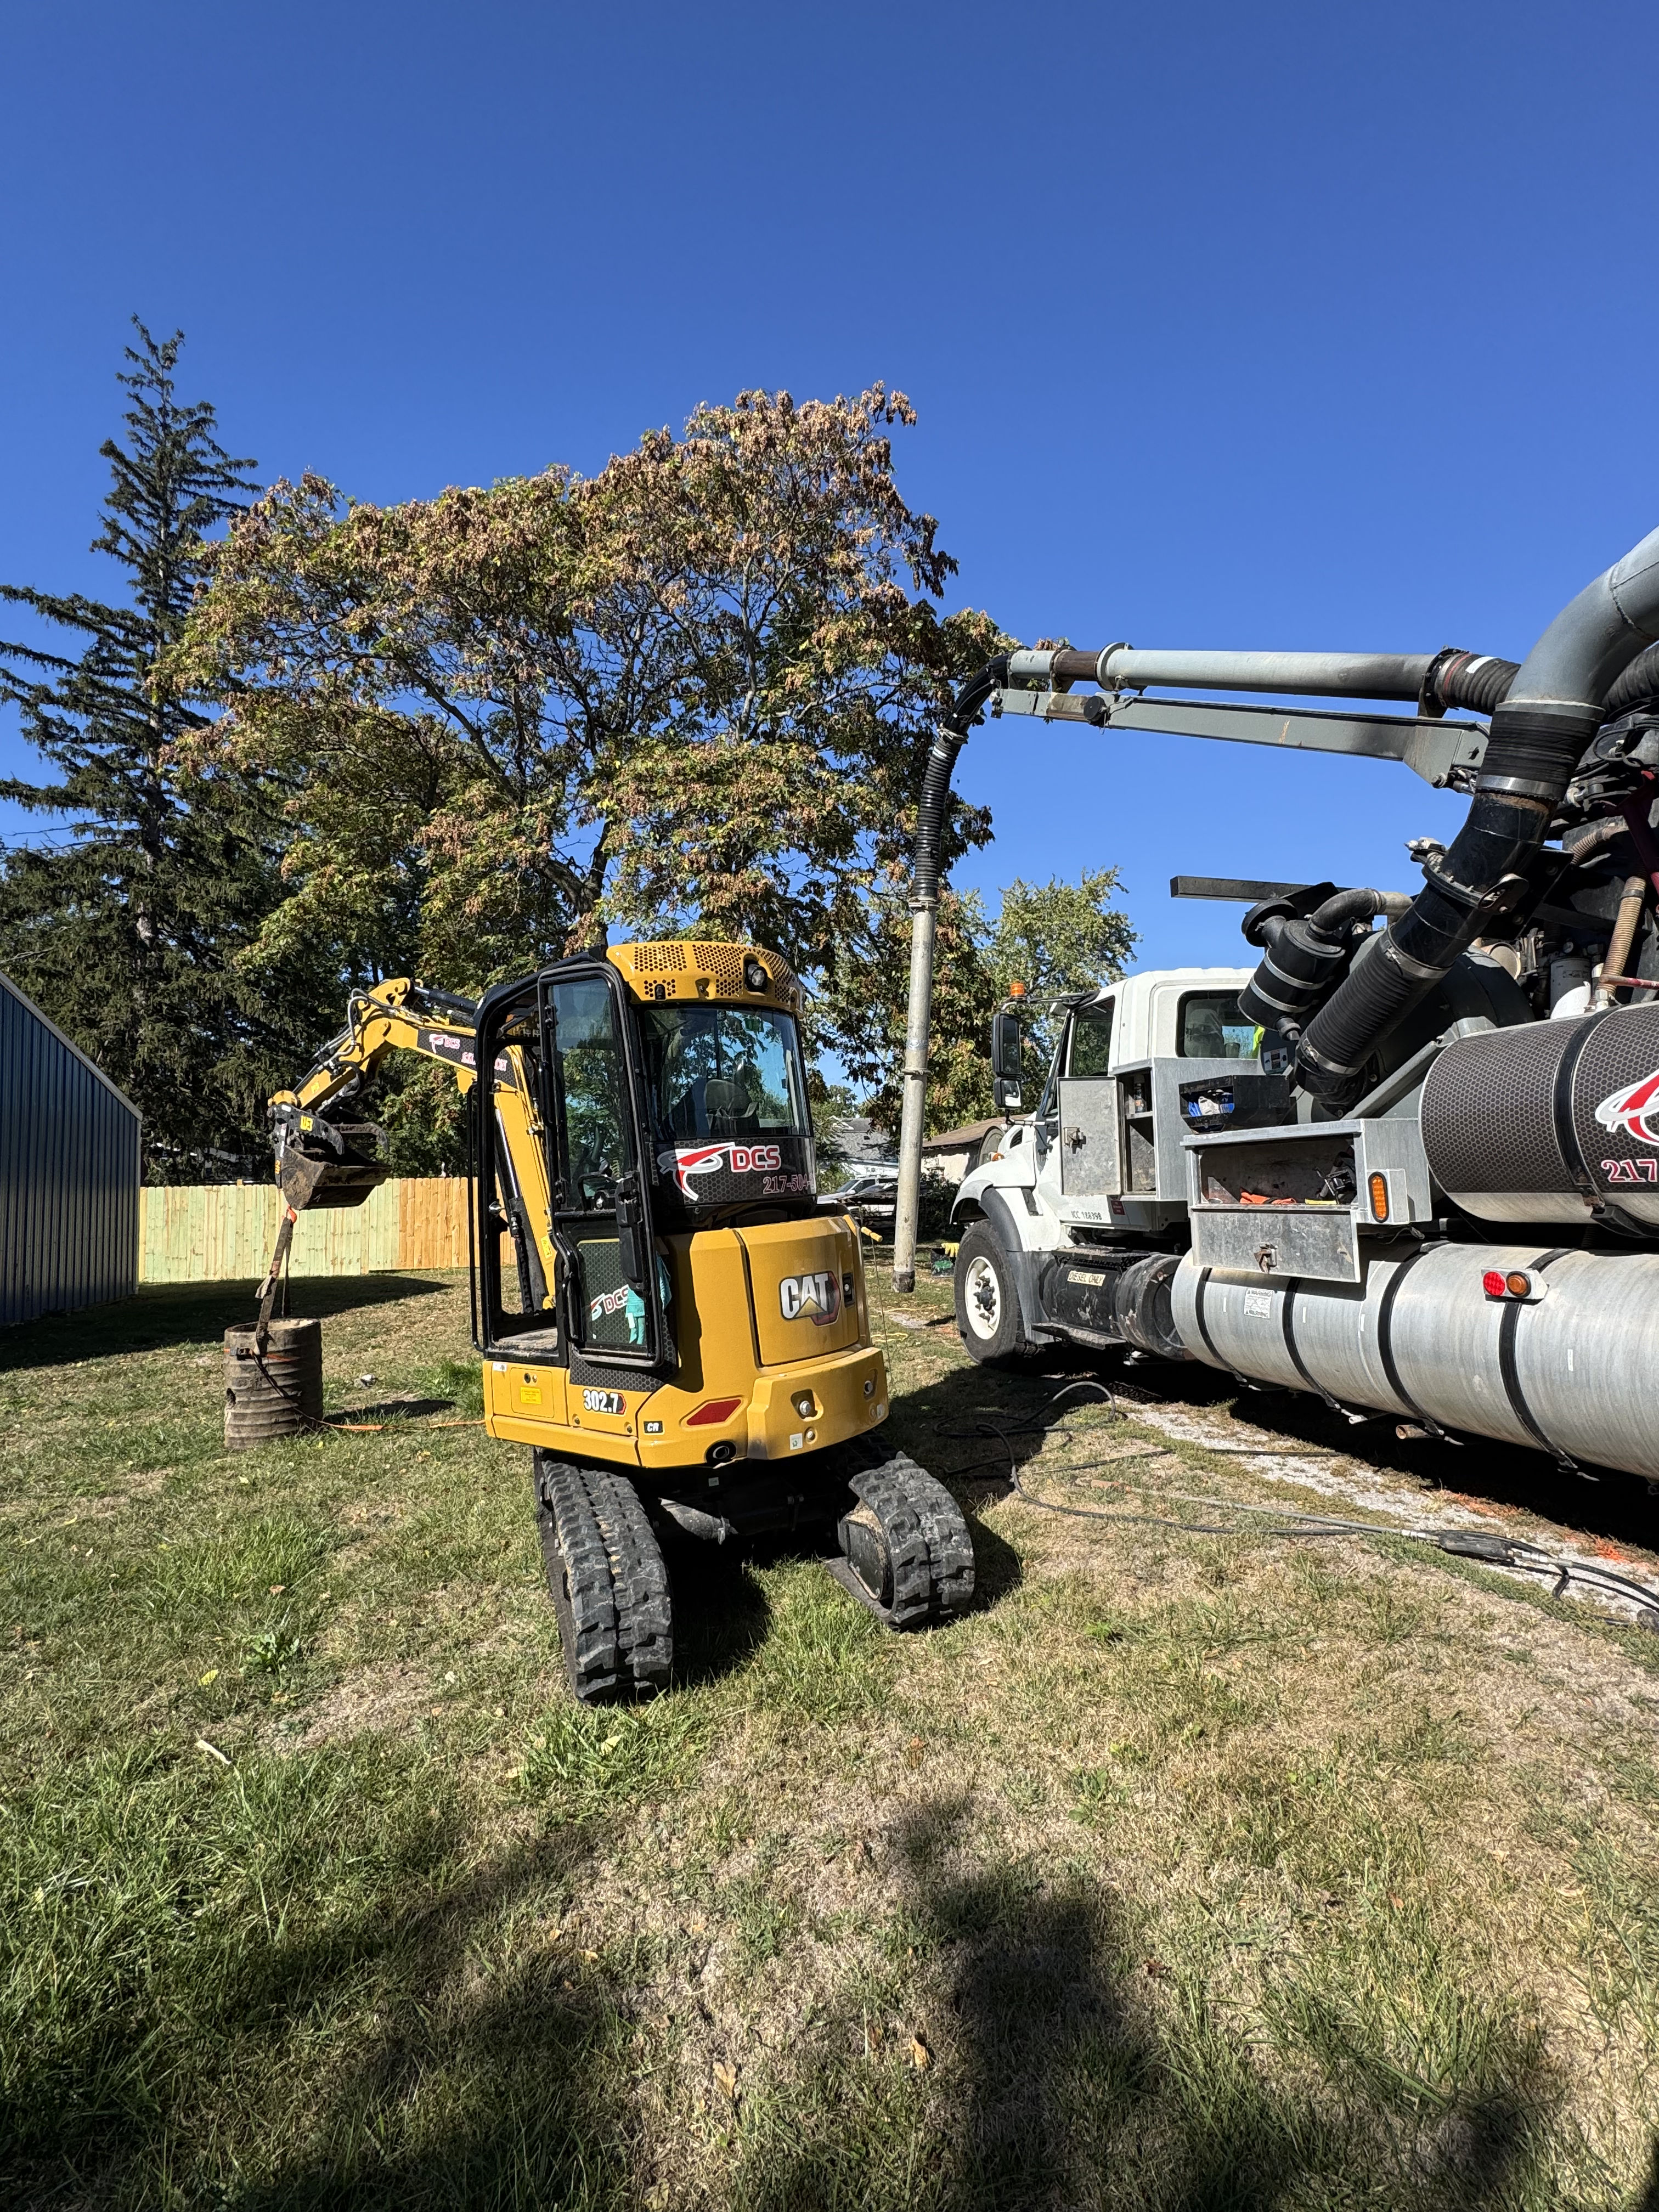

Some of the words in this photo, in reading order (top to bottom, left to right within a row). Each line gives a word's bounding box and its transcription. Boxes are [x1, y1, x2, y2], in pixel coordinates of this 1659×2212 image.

[730, 1146, 781, 1172] DCS
[1601, 1159, 1657, 1183] 217
[1070, 1210, 1081, 1220] ICC
[780, 1273, 828, 1319] CAT
[583, 1389, 619, 1413] 302.7
[647, 1422, 659, 1432] CR
